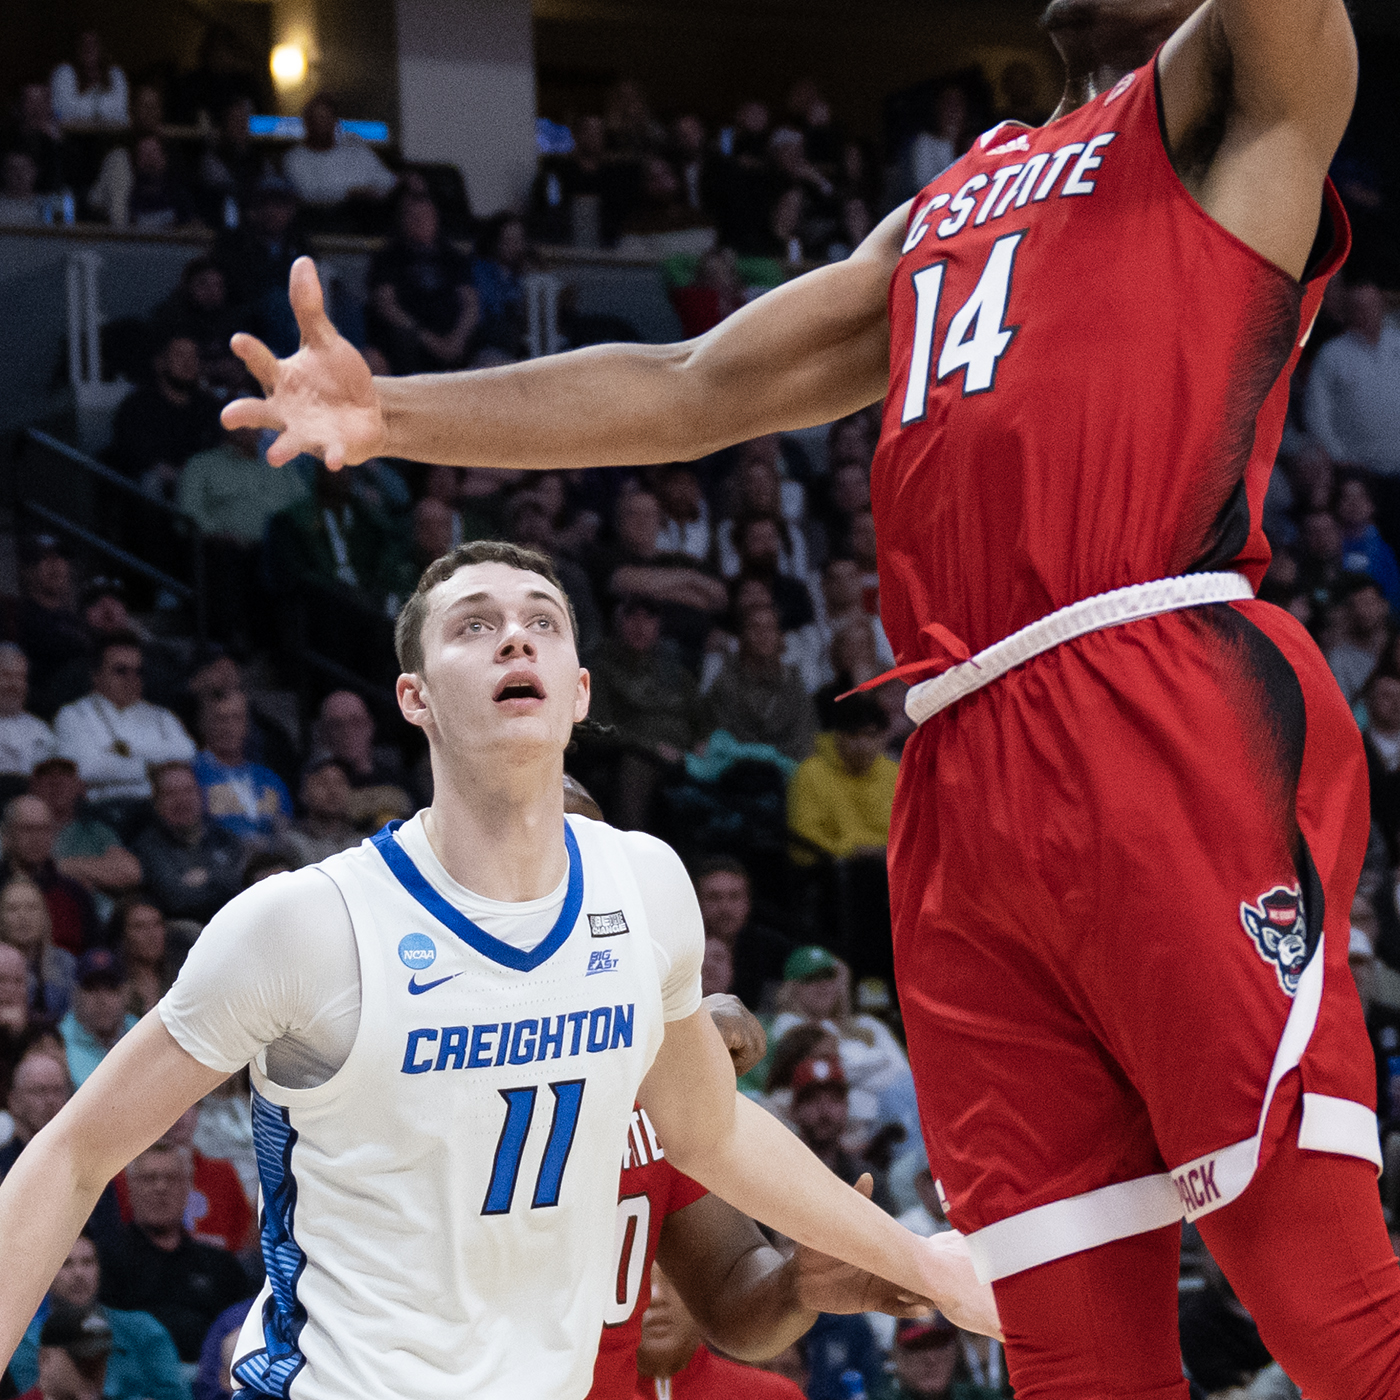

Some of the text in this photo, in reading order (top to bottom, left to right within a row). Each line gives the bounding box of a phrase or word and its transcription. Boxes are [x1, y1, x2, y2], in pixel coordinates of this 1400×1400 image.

[901, 228, 1030, 427] 14
[403, 949, 435, 960] NCAA
[587, 958, 619, 971] EAST
[590, 949, 613, 961] BIG
[401, 1003, 634, 1075] CREIGHTON
[480, 1078, 587, 1216] 11
